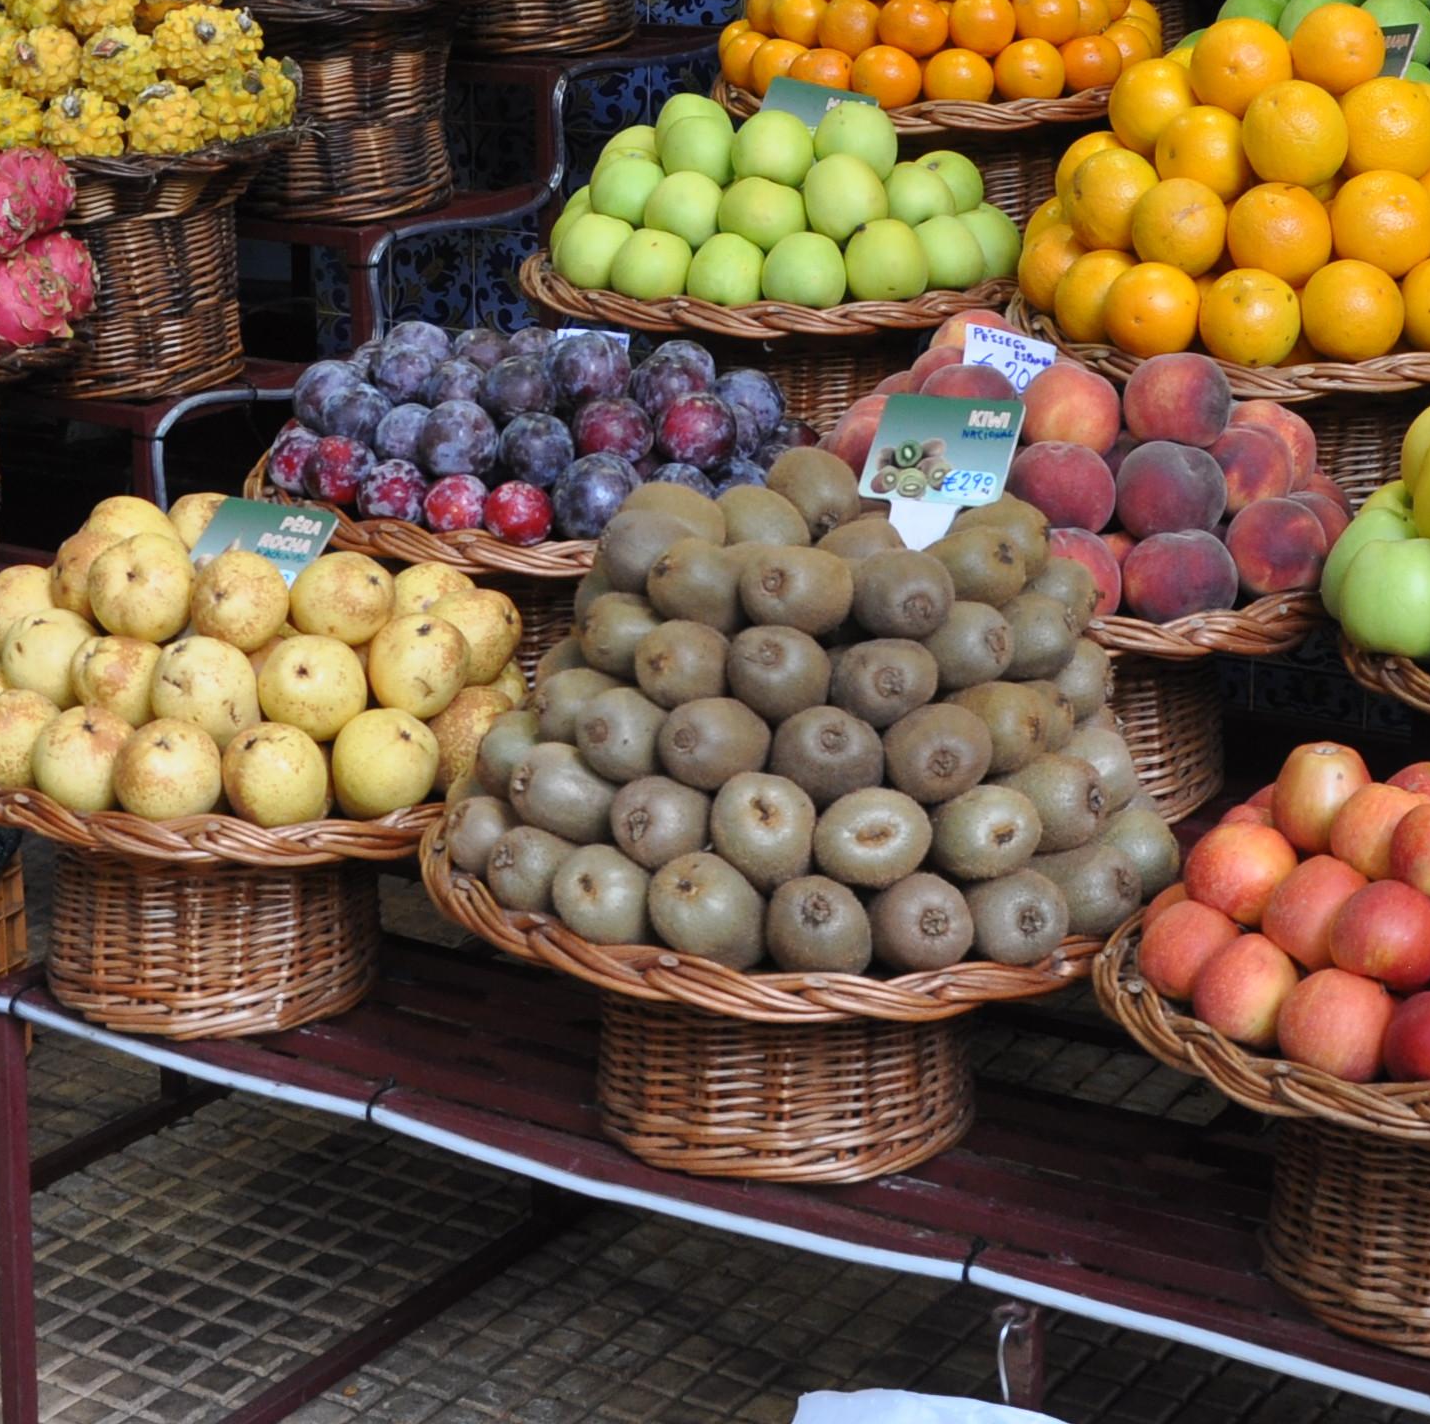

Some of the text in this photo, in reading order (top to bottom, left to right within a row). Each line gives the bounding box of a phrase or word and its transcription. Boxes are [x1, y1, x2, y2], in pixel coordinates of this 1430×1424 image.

[968, 409, 1012, 429] KIWI
[278, 514, 323, 536] PÊRA
[256, 532, 311, 553] ROCHA
